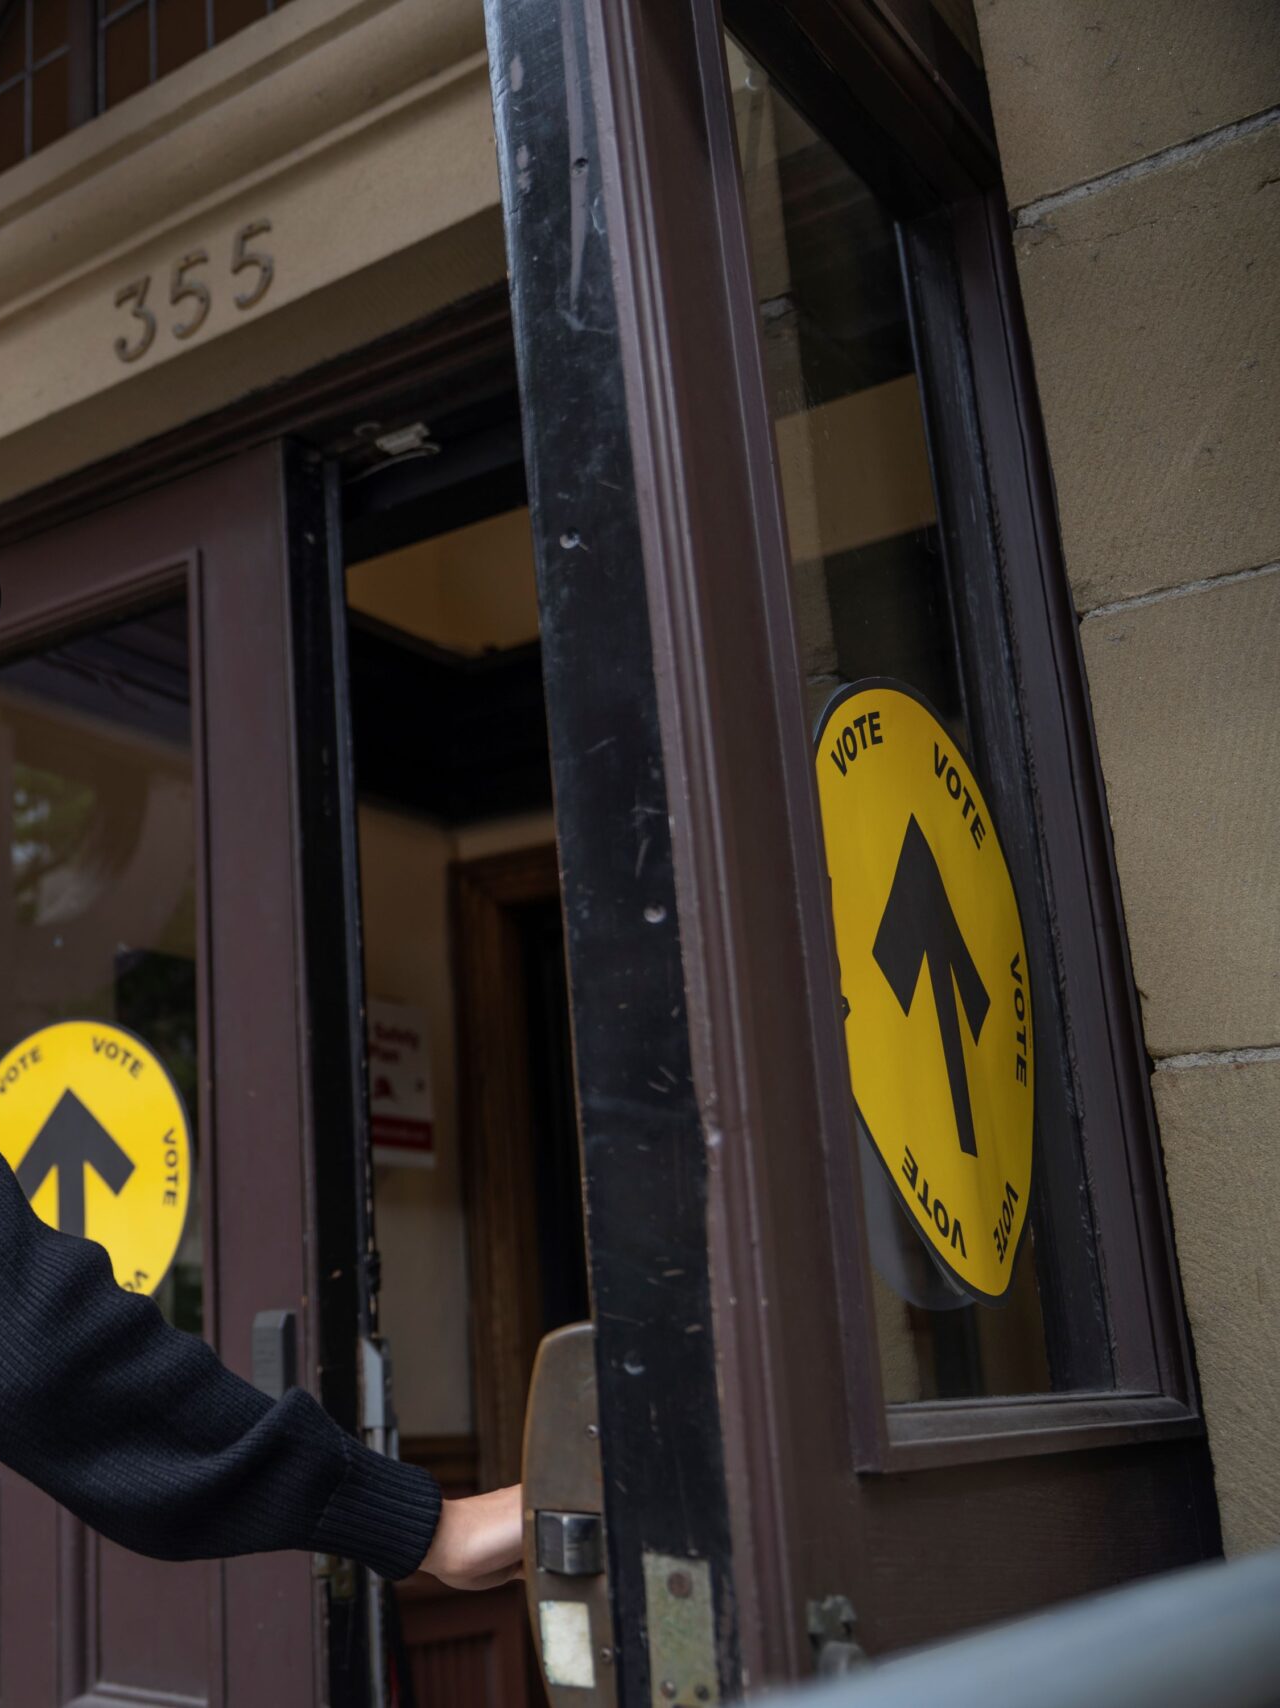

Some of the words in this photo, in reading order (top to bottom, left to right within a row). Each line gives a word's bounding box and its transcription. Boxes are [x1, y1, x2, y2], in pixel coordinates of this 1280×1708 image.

[114, 219, 275, 363] 355
[830, 711, 884, 777] VOTE
[933, 741, 987, 850] VOTE
[92, 1035, 145, 1079] VOTE
[1010, 952, 1028, 1088] VOTE
[162, 1127, 178, 1207] VOTE
[901, 1145, 968, 1260] VOTE
[993, 1181, 1020, 1264] VOTE
